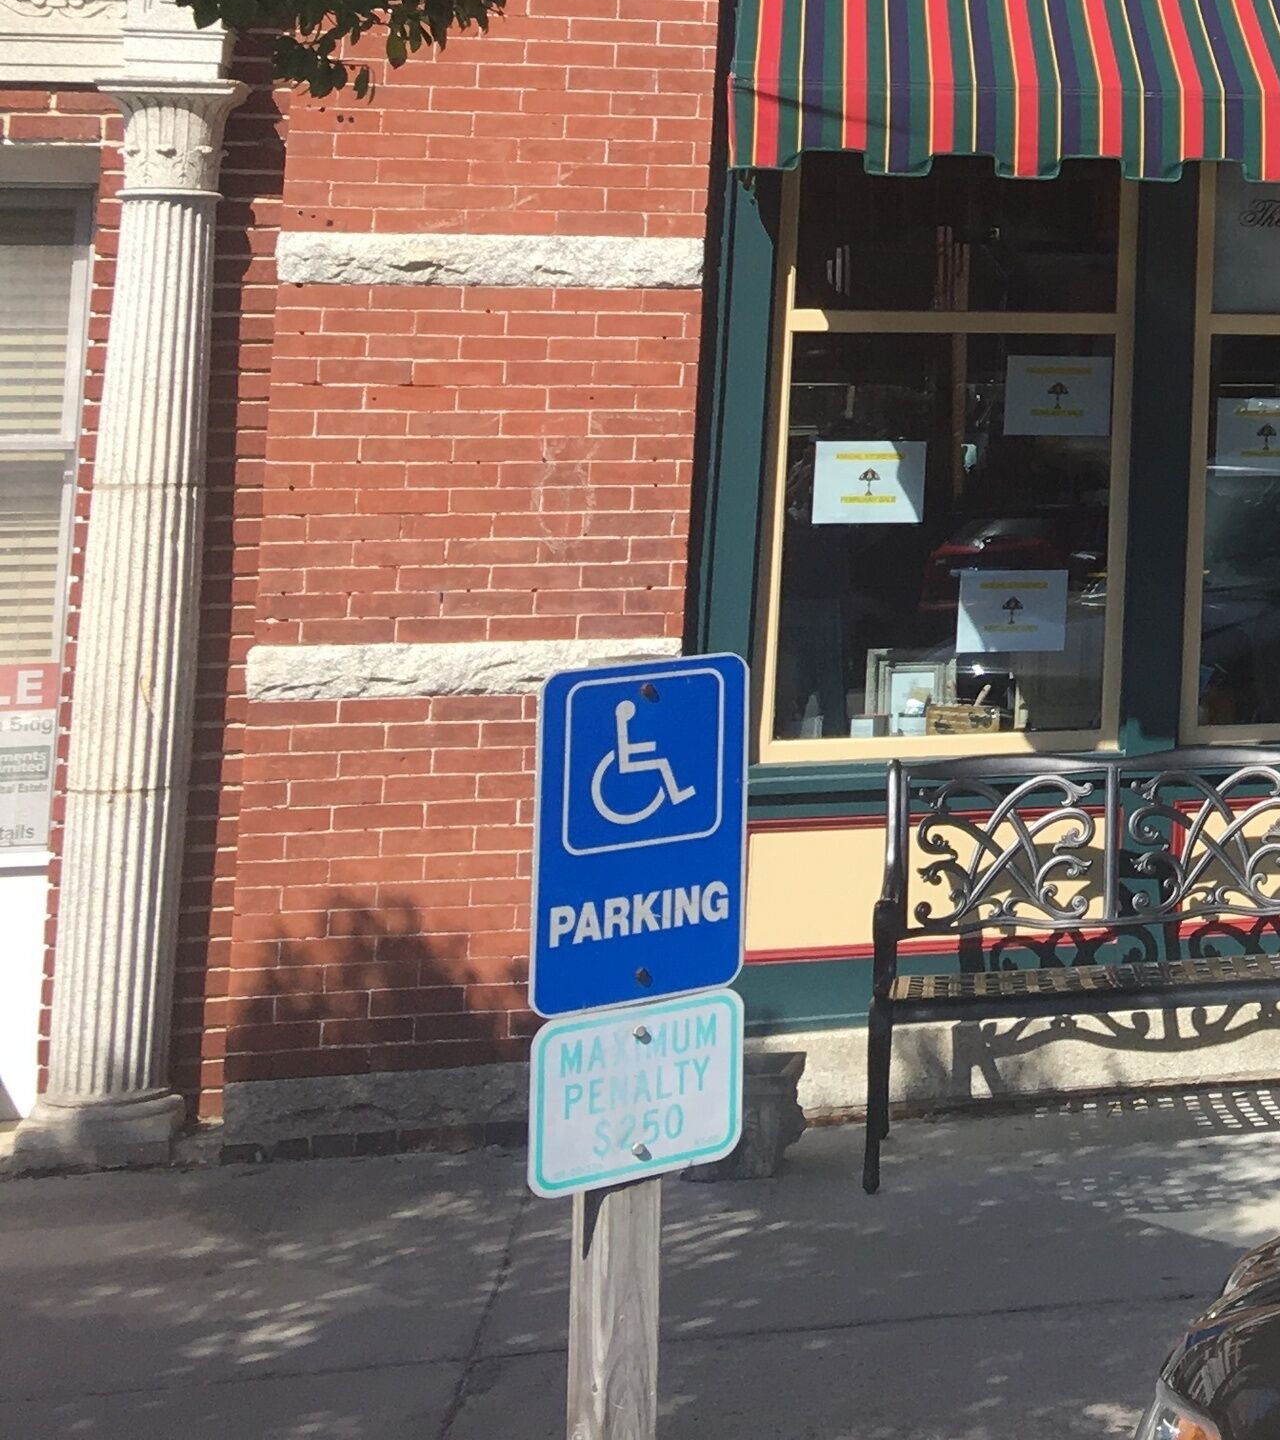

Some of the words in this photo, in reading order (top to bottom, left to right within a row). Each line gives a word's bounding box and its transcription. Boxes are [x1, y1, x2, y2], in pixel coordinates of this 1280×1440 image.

[549, 881, 729, 949] PARKING
[564, 1057, 710, 1121] PENALTY
[593, 1104, 684, 1160] $250
